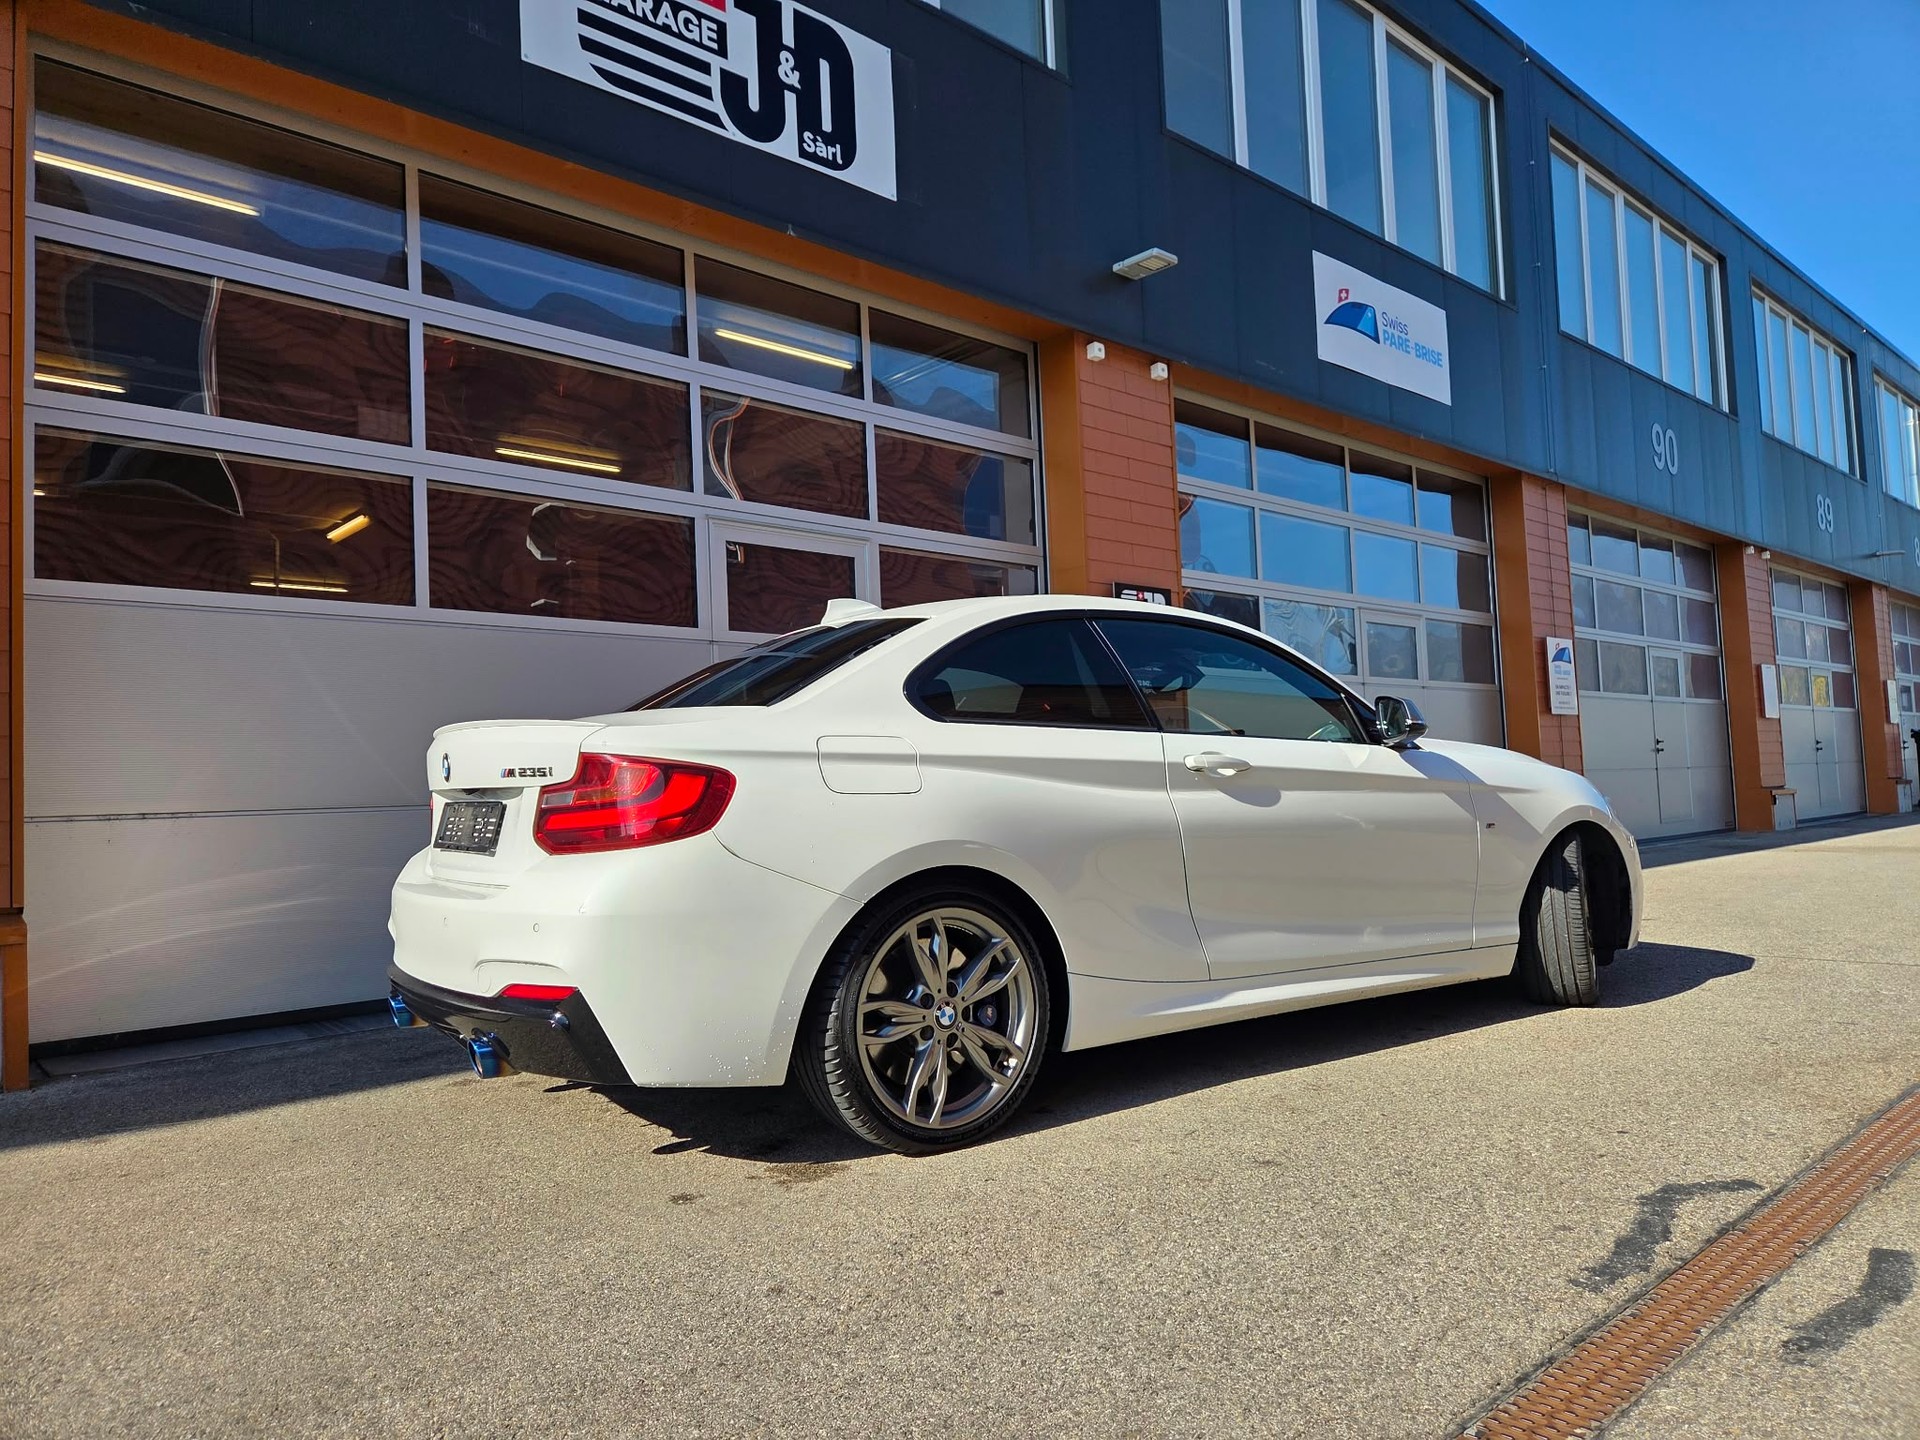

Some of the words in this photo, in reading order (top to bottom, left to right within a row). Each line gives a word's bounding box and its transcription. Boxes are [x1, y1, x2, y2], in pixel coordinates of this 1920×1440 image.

[802, 130, 843, 165] Sàrl
[1381, 311, 1409, 336] Swiss
[1382, 329, 1444, 369] PARE-BRISE
[1651, 422, 1678, 475] 90
[1816, 494, 1834, 533] 89
